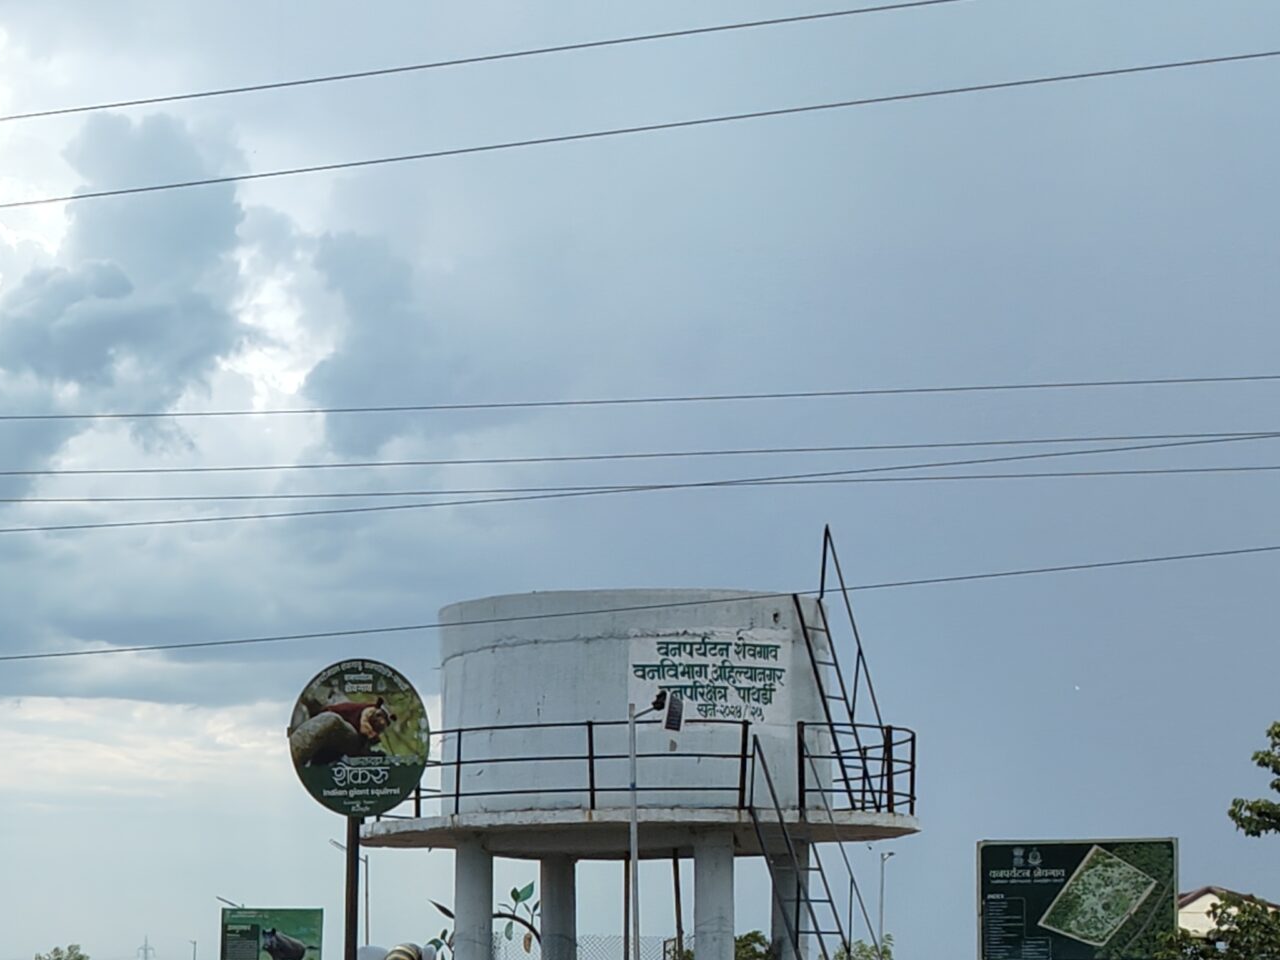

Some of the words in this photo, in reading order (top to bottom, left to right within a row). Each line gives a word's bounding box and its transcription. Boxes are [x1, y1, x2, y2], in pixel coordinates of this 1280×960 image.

[657, 636, 732, 659] वनपर्यटन
[734, 637, 781, 661] शेवगाव
[632, 658, 710, 681] वनविभाग
[710, 660, 786, 686] अहिल्यानगर
[323, 788, 348, 797] Indian
[349, 788, 370, 798] giant
